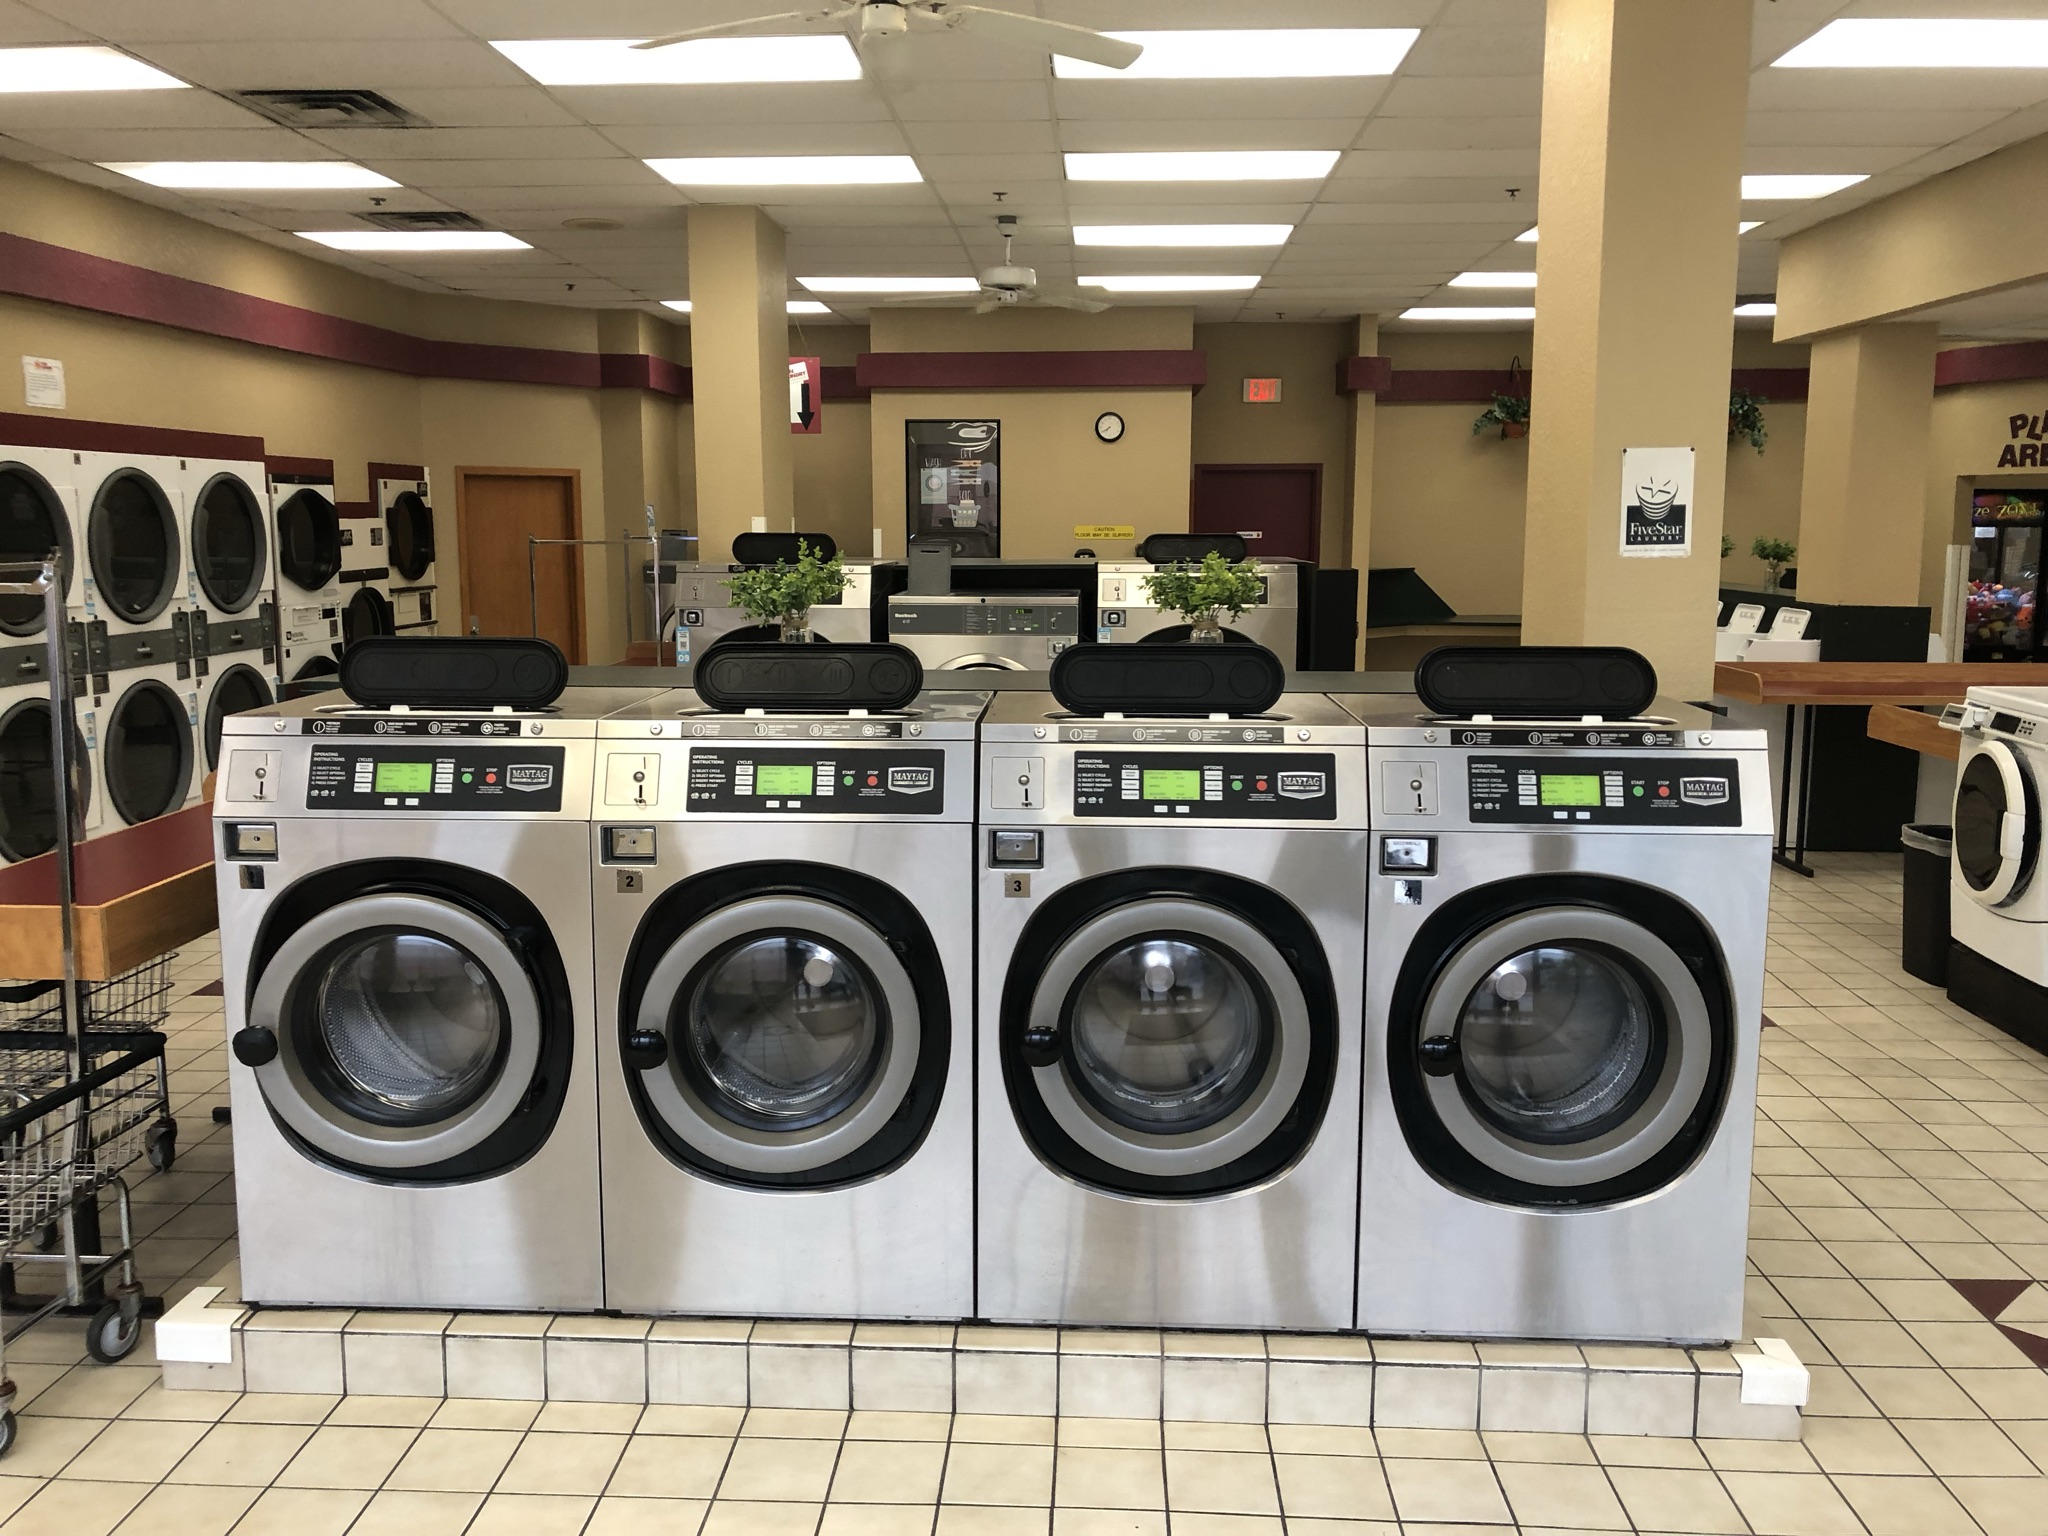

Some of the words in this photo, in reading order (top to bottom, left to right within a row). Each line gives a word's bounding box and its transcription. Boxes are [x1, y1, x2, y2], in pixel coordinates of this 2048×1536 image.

[1249, 379, 1277, 401] EXIT
[1630, 521, 1683, 536] FiveStar
[512, 770, 548, 778] MAYTAG
[1283, 777, 1320, 786] MAYTAG
[1686, 783, 1723, 792] MAYTAG
[625, 875, 634, 888] 2
[1013, 880, 1022, 892] 3
